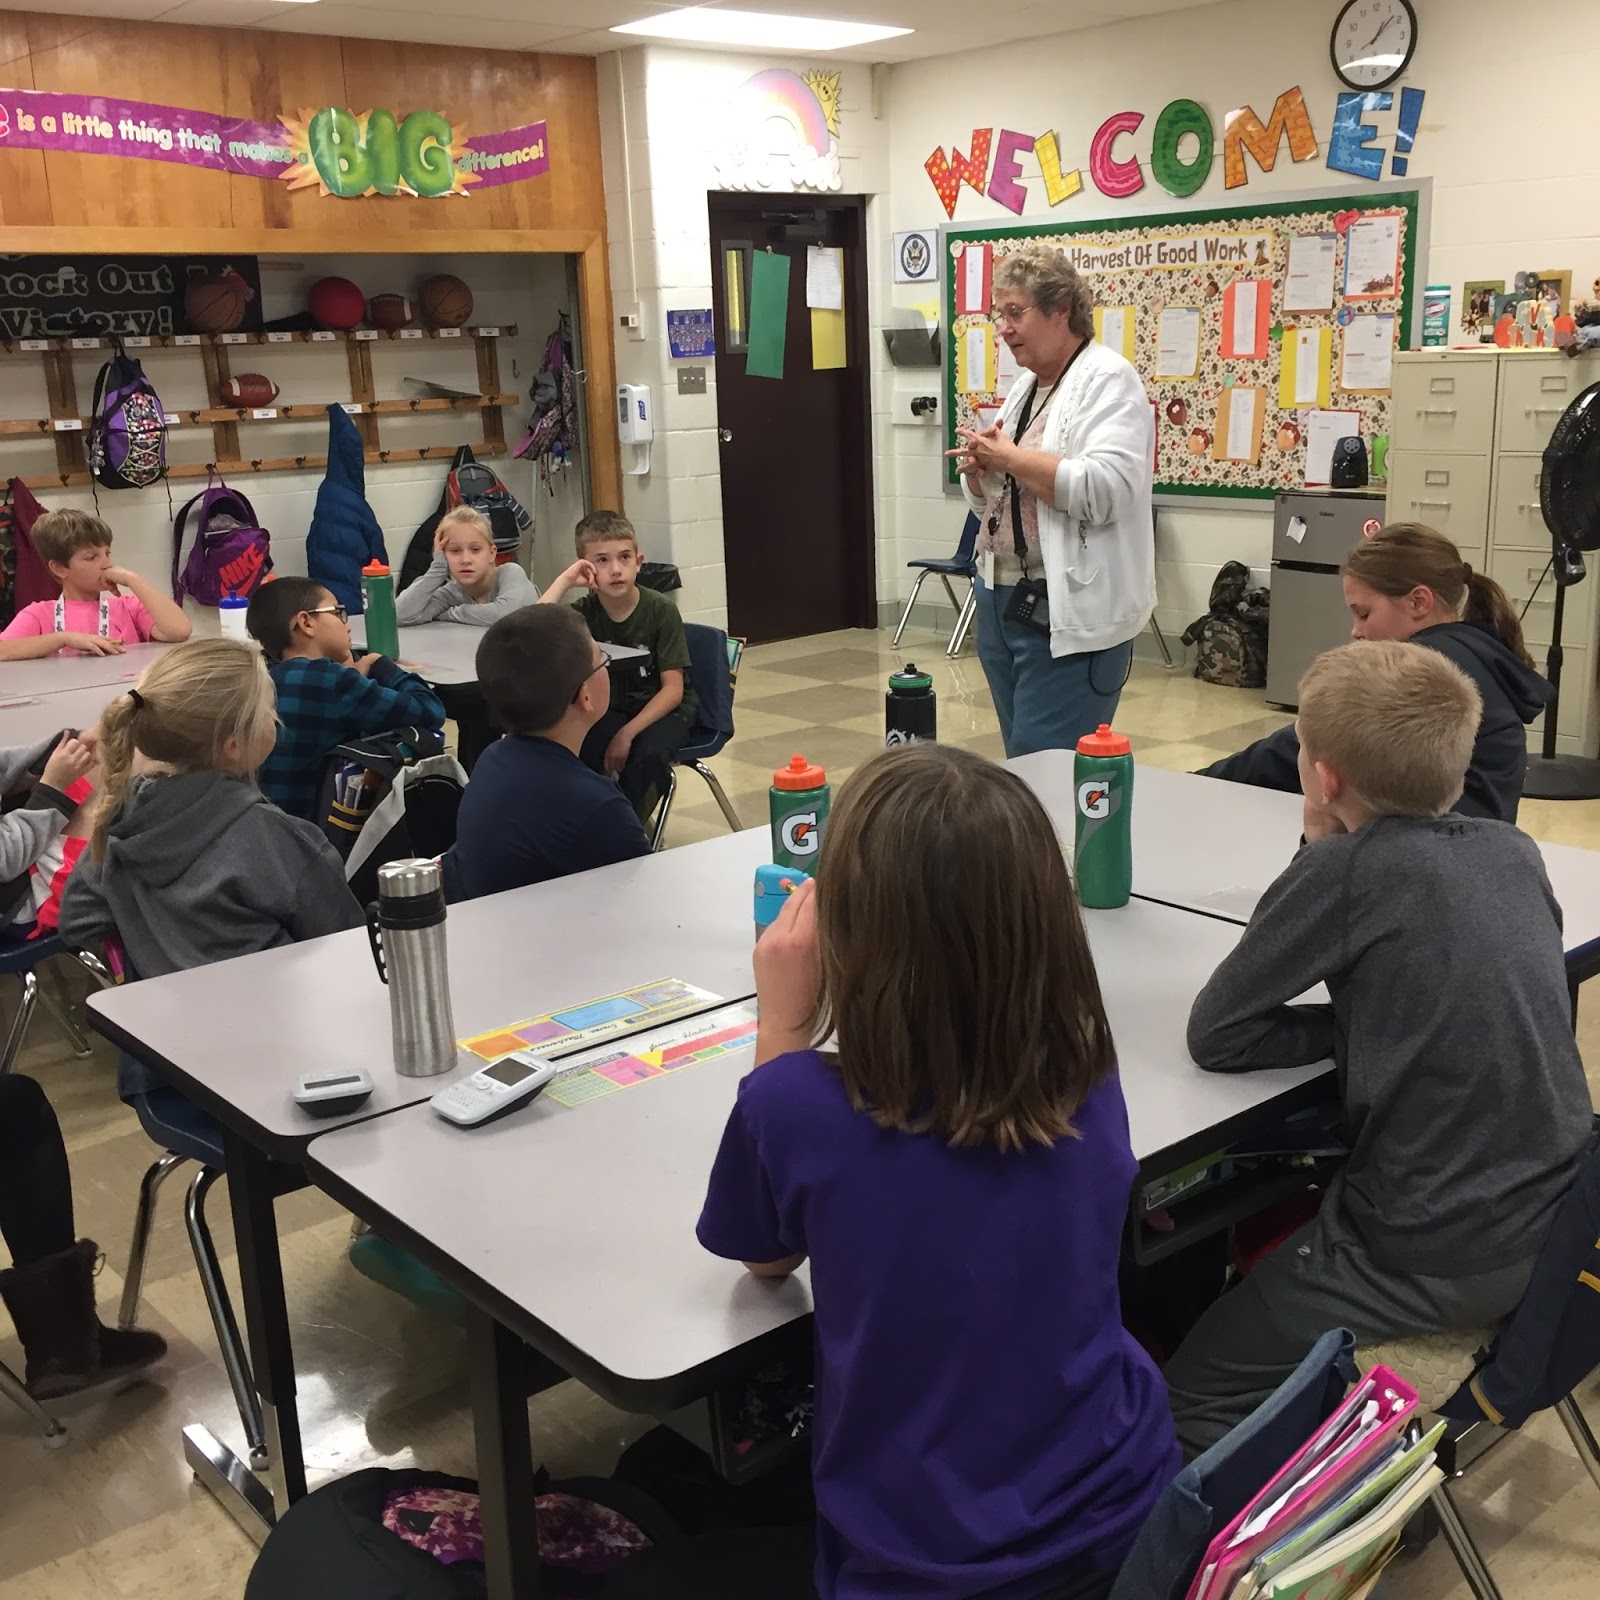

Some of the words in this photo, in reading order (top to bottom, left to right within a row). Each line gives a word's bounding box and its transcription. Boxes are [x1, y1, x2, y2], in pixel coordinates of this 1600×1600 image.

[1360, 9, 1367, 18] 11
[1372, 2, 1381, 12] 12
[1349, 22, 1358, 32] 10
[1396, 14, 1403, 24] 2
[1345, 39, 1352, 49] 9
[1399, 30, 1406, 40] 3
[1371, 67, 1378, 77] 6
[16, 107, 36, 132] is
[41, 115, 57, 133] a
[62, 111, 114, 139] little
[118, 119, 173, 150] thing
[177, 128, 222, 154] that
[229, 140, 293, 164] makes
[297, 150, 309, 166] a
[308, 106, 454, 197] BIG
[458, 138, 545, 173] difference!
[924, 85, 1425, 220] WELCOME!
[1071, 246, 1132, 270] Harvest
[1156, 240, 1197, 264] Good
[1203, 237, 1248, 262] Work
[98, 263, 175, 294] Out
[219, 542, 265, 588] NIKE
[1077, 781, 1110, 820] G
[781, 811, 819, 856] G
